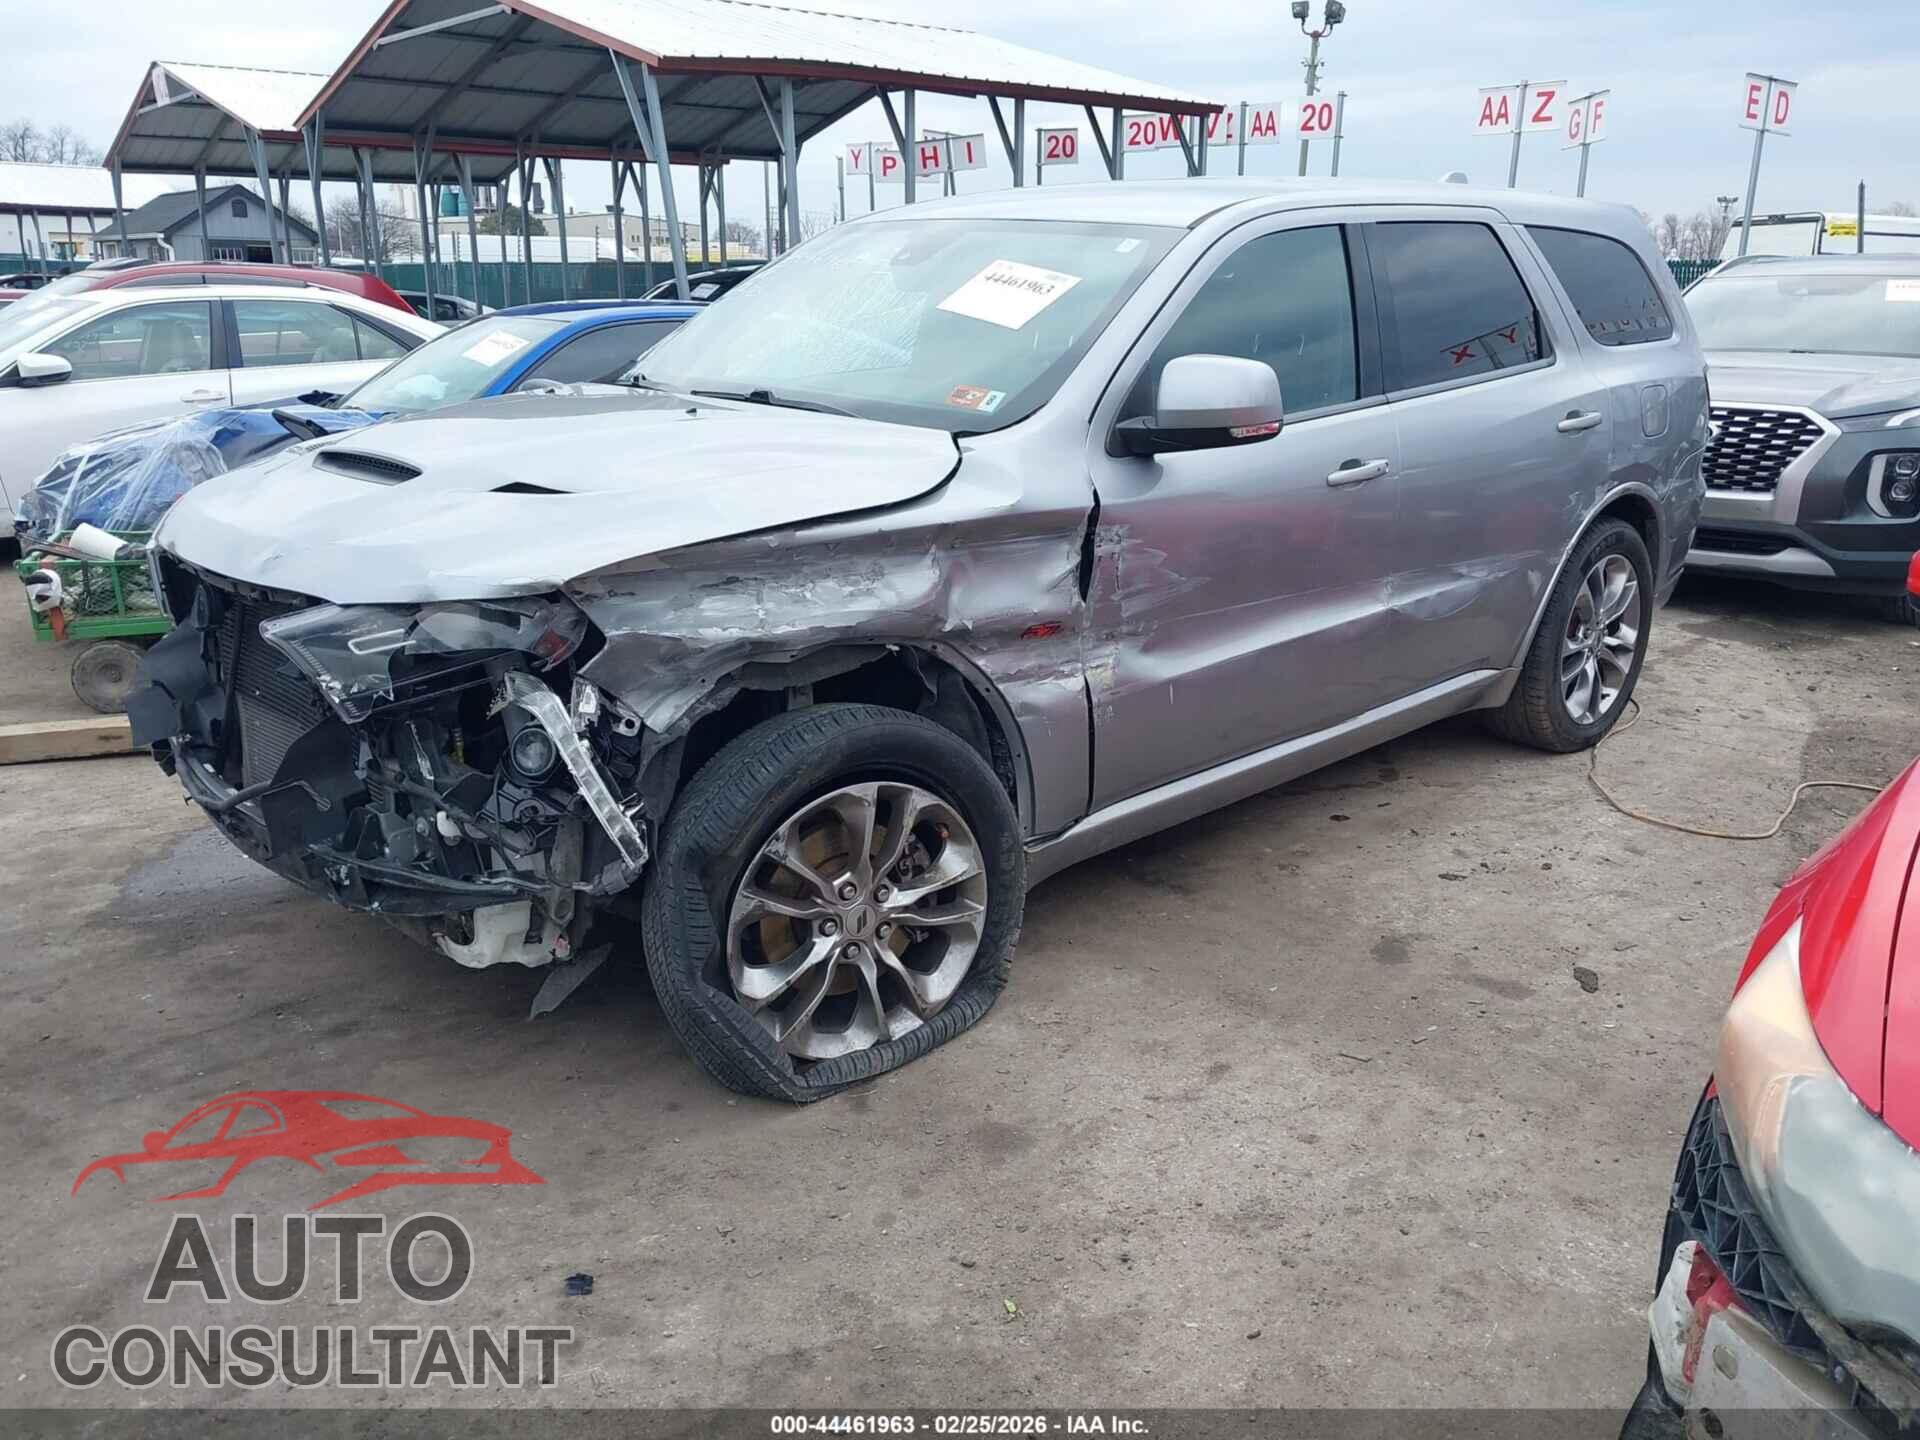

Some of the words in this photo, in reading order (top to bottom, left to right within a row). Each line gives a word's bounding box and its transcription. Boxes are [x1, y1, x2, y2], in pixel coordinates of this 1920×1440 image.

[1300, 103, 1333, 131] 20
[1479, 95, 1509, 127] AA
[1532, 90, 1556, 123] Z
[1746, 85, 1762, 120] E
[1774, 90, 1789, 124] D
[1128, 121, 1156, 145] 20
[1251, 111, 1277, 137] AA
[1569, 108, 1581, 140] G
[1592, 101, 1604, 133] F
[850, 149, 862, 169] Y
[921, 145, 939, 170] H
[1046, 135, 1076, 159] 20
[882, 156, 897, 177] P
